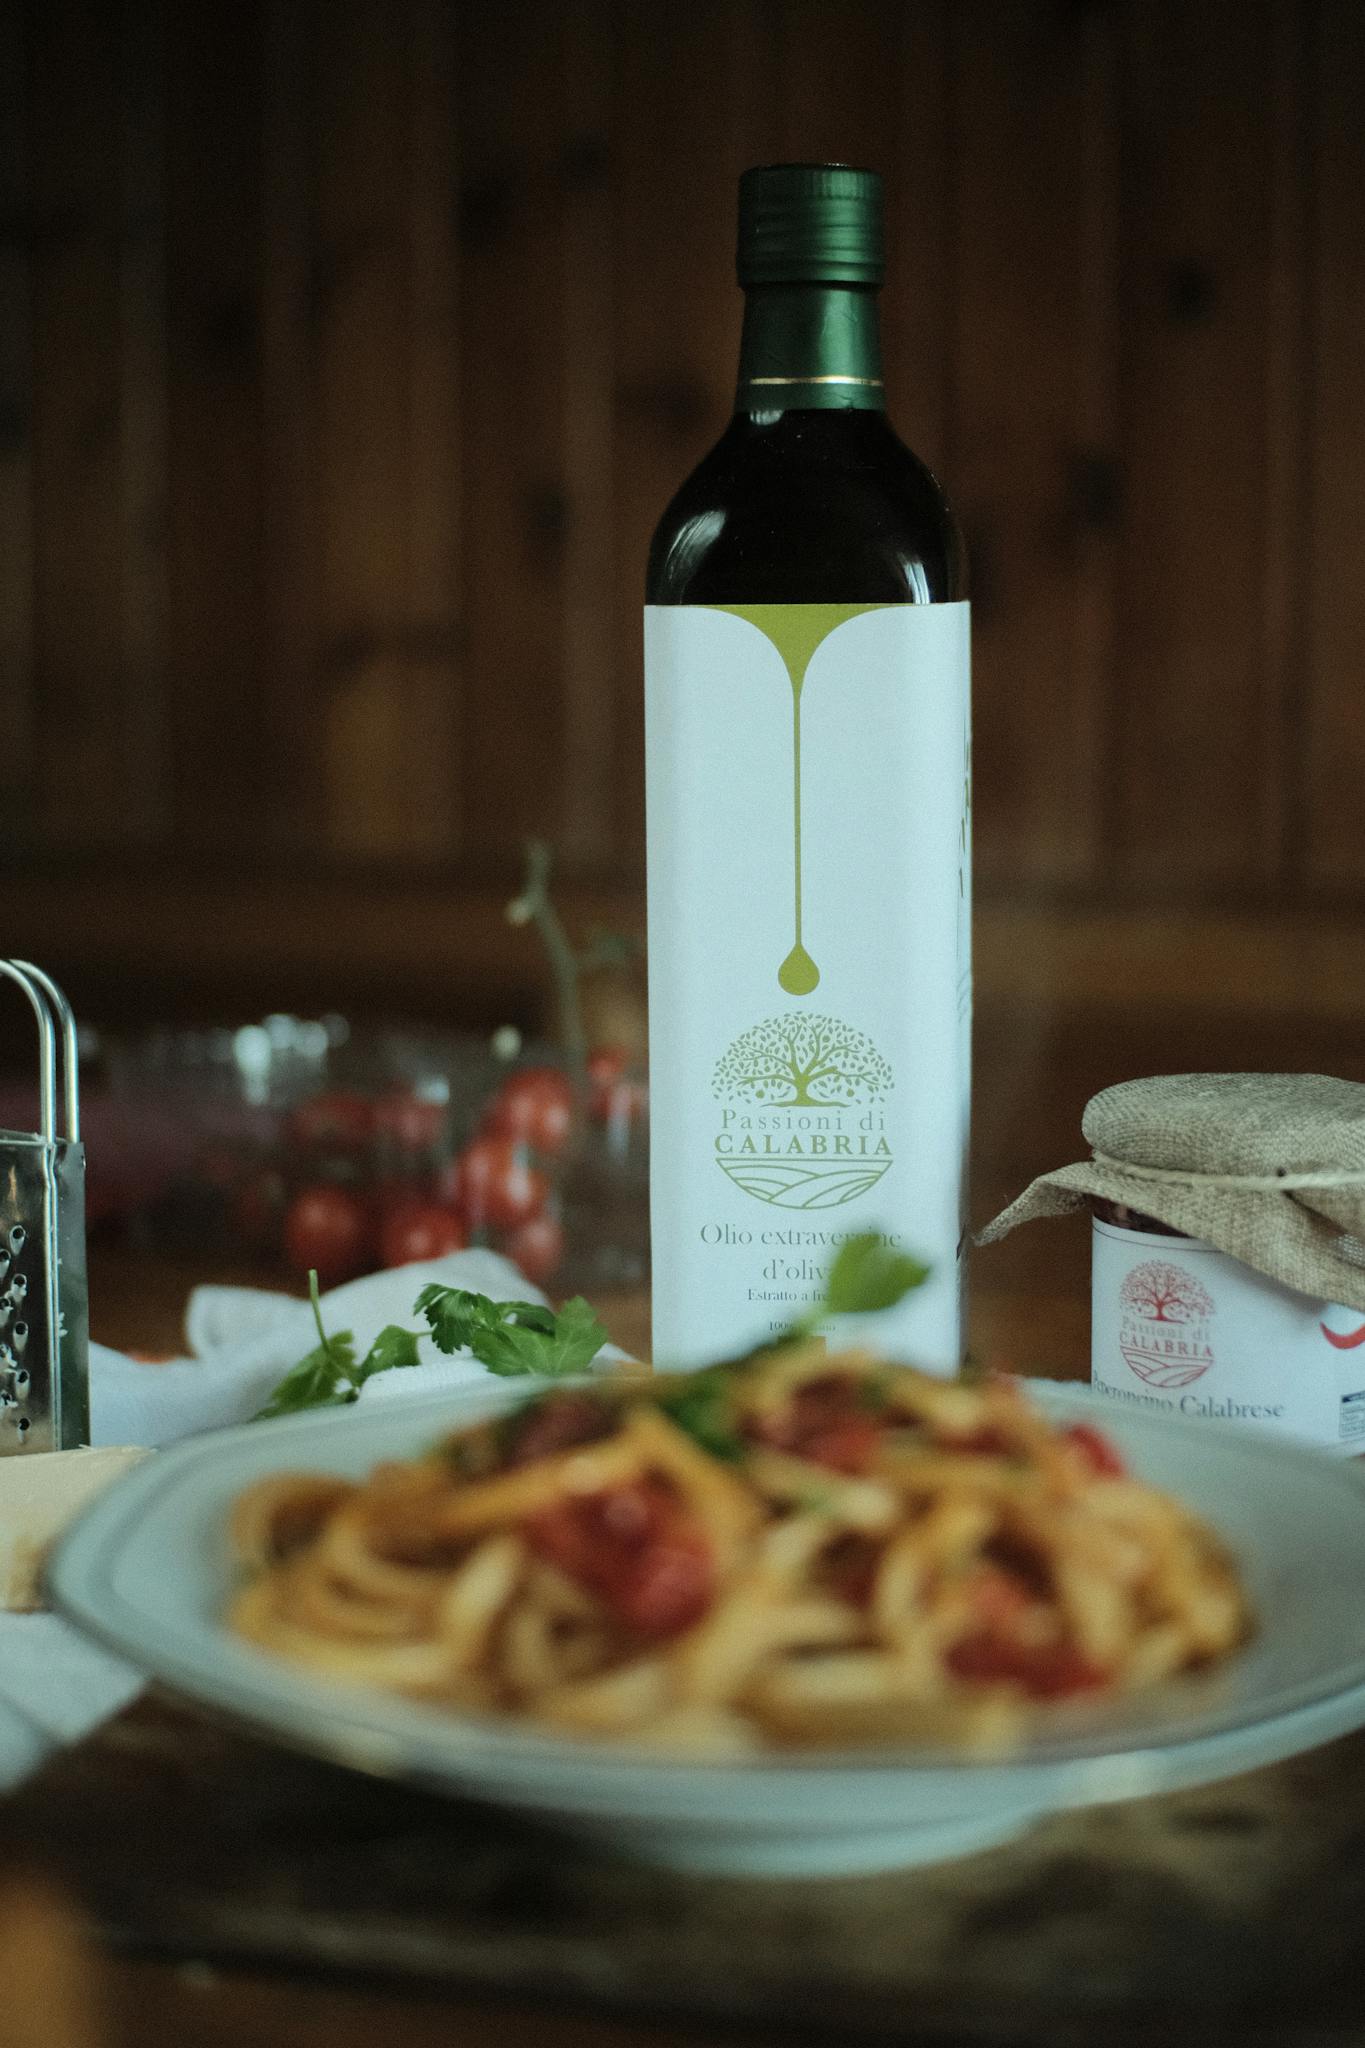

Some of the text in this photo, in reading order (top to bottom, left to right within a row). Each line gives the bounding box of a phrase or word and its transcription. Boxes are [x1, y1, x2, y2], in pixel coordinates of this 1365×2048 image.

[721, 1108, 886, 1132] Passioni di
[714, 1133, 894, 1156] CALABRIA
[700, 1223, 753, 1246] Olio
[762, 1258, 831, 1282] d'oliv
[748, 1287, 799, 1302] Estratto
[800, 1292, 809, 1302] a
[1119, 1330, 1214, 1358] CALABRIA
[1179, 1394, 1285, 1419] Calabrese
